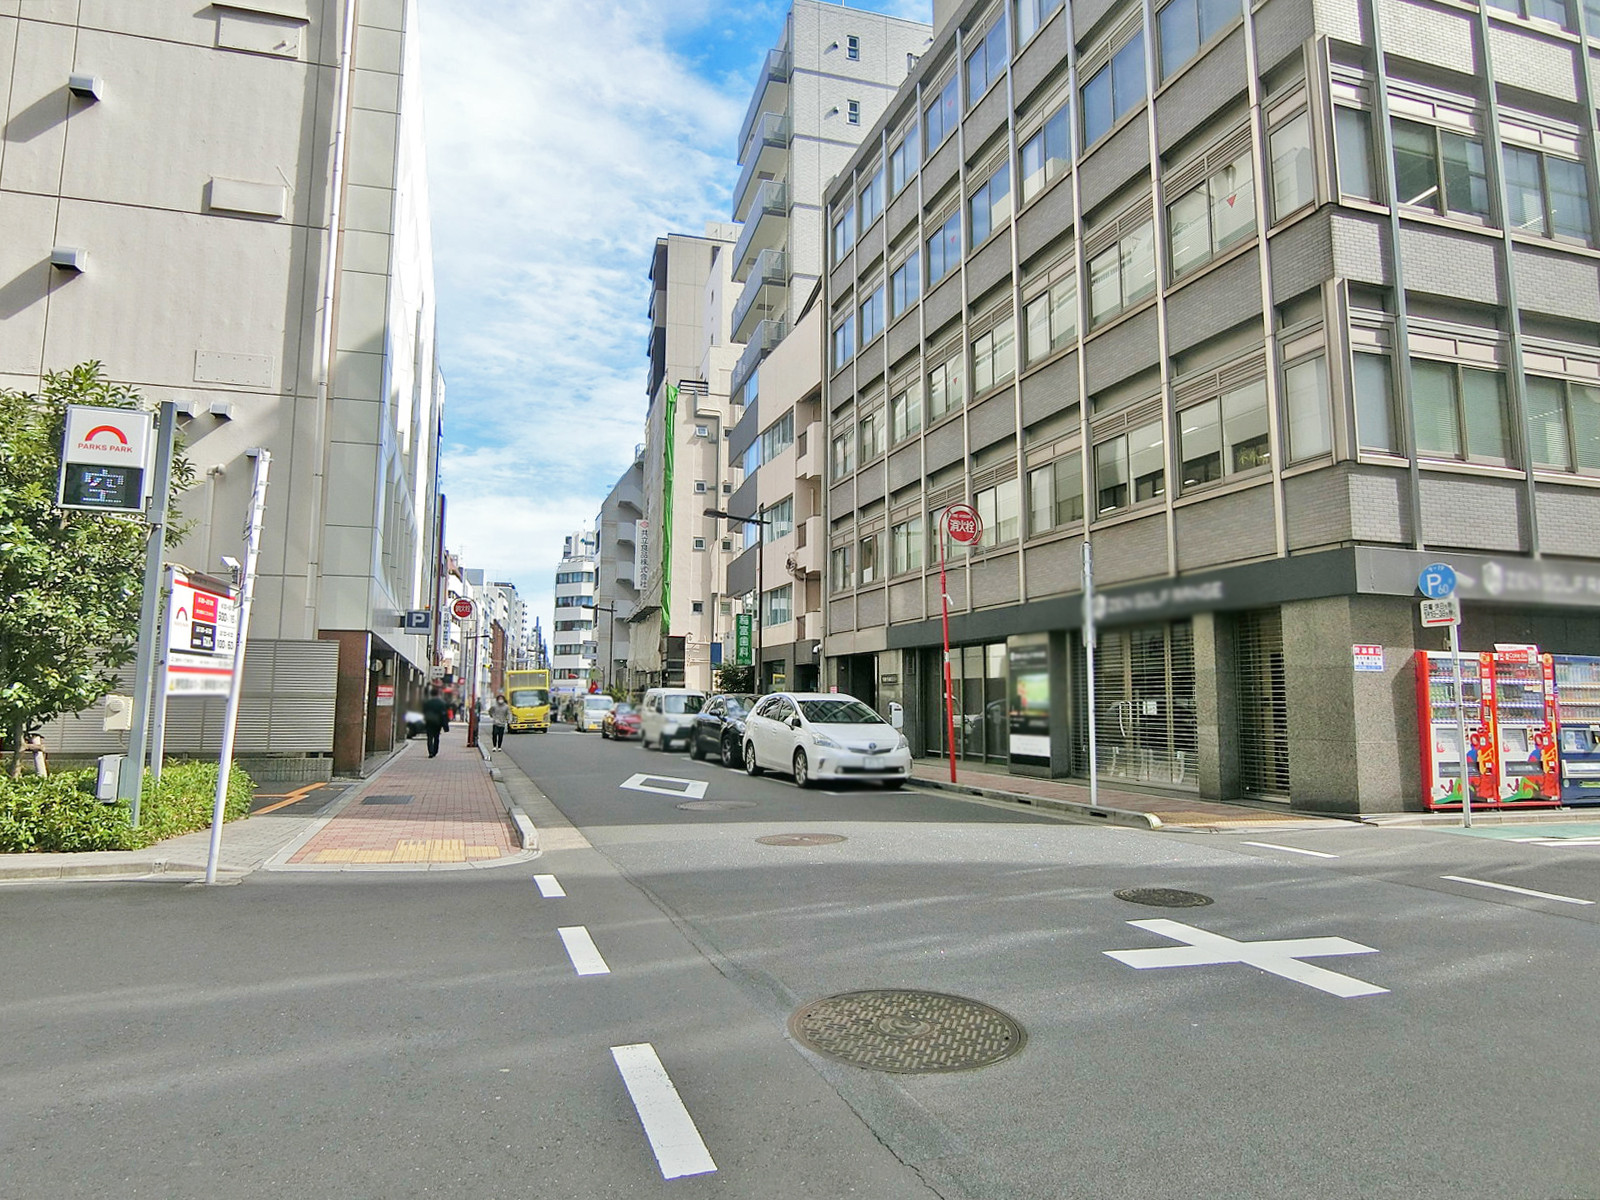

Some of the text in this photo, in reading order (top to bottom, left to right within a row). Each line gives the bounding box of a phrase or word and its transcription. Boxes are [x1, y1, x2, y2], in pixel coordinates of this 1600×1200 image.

[78, 443, 133, 453] PARKS PARK
[83, 469, 124, 502] 空
[949, 519, 975, 533] 消火栓
[1426, 573, 1442, 596] P
[412, 613, 425, 627] P
